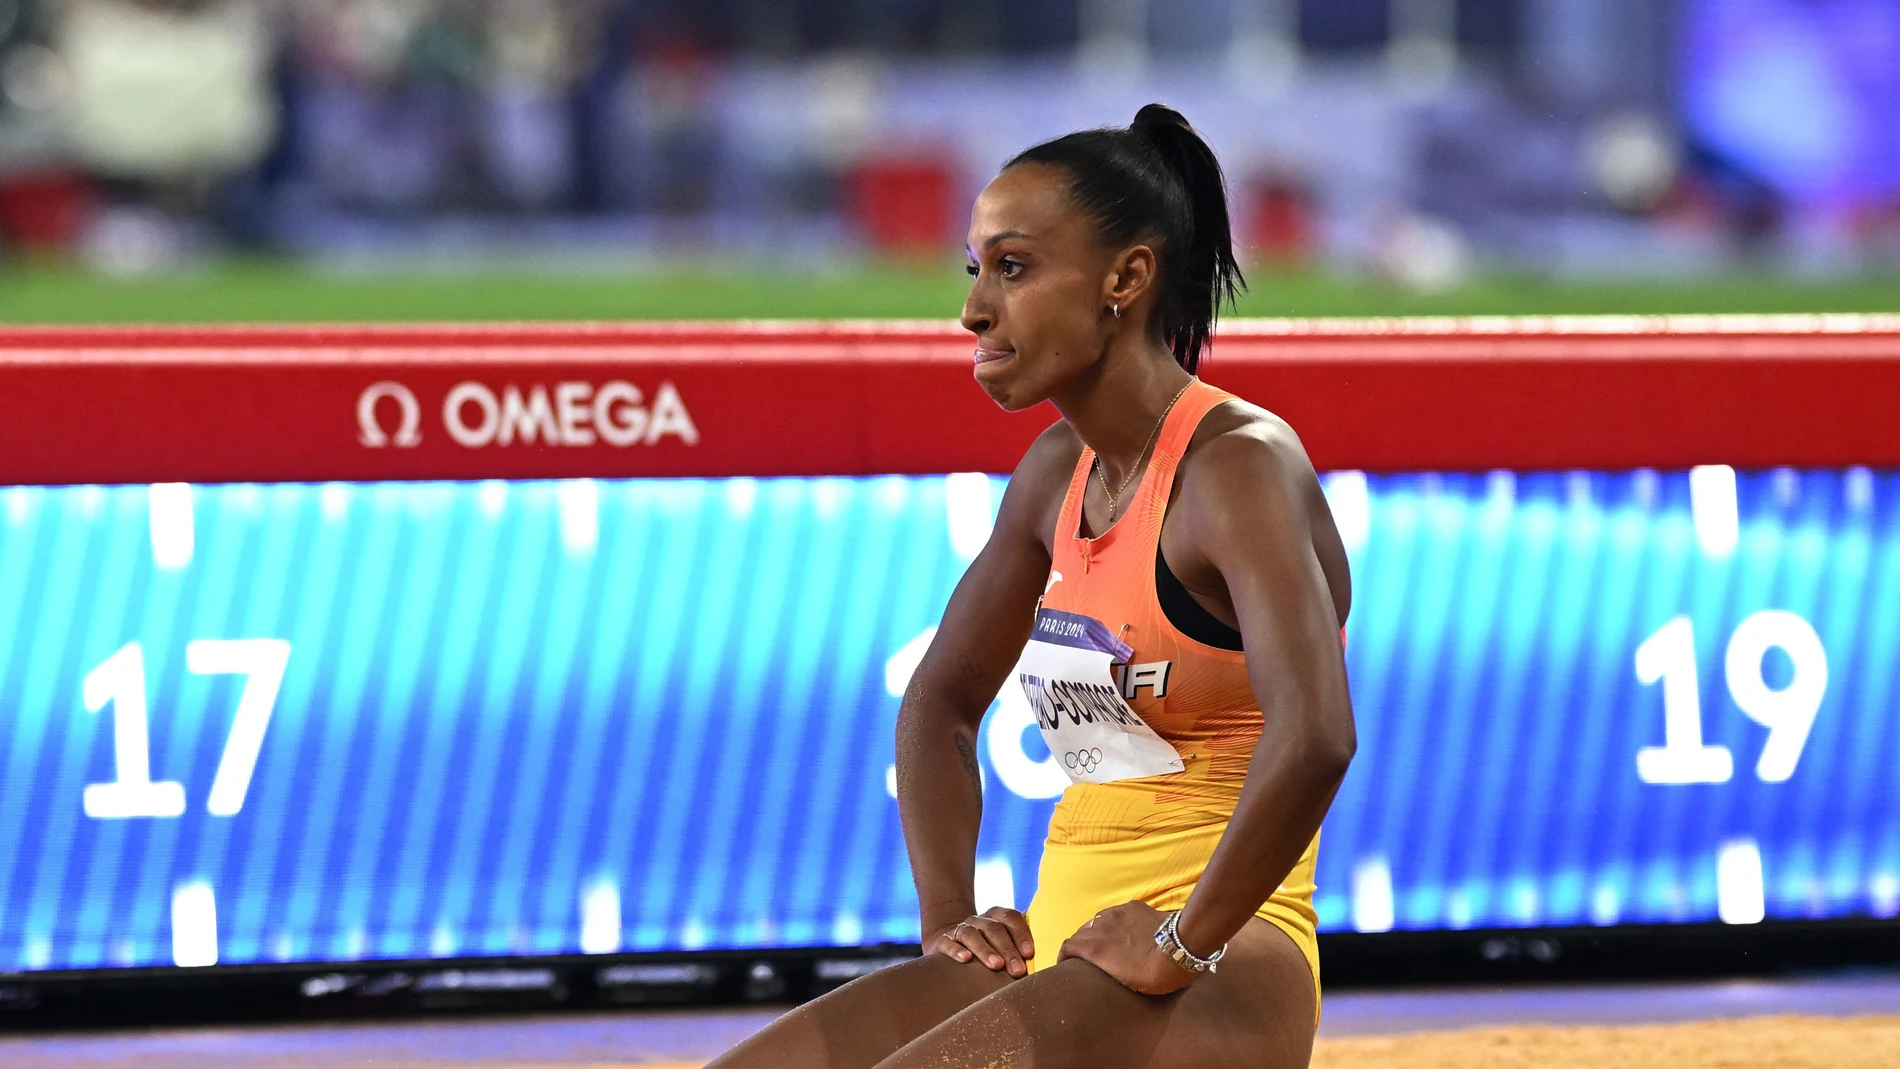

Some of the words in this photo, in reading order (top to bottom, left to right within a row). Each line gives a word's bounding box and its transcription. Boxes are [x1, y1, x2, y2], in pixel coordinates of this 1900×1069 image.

[442, 380, 700, 448] OMEGA
[1064, 622, 1086, 638] 2024
[84, 638, 291, 819] 17
[1635, 609, 1828, 785] 19
